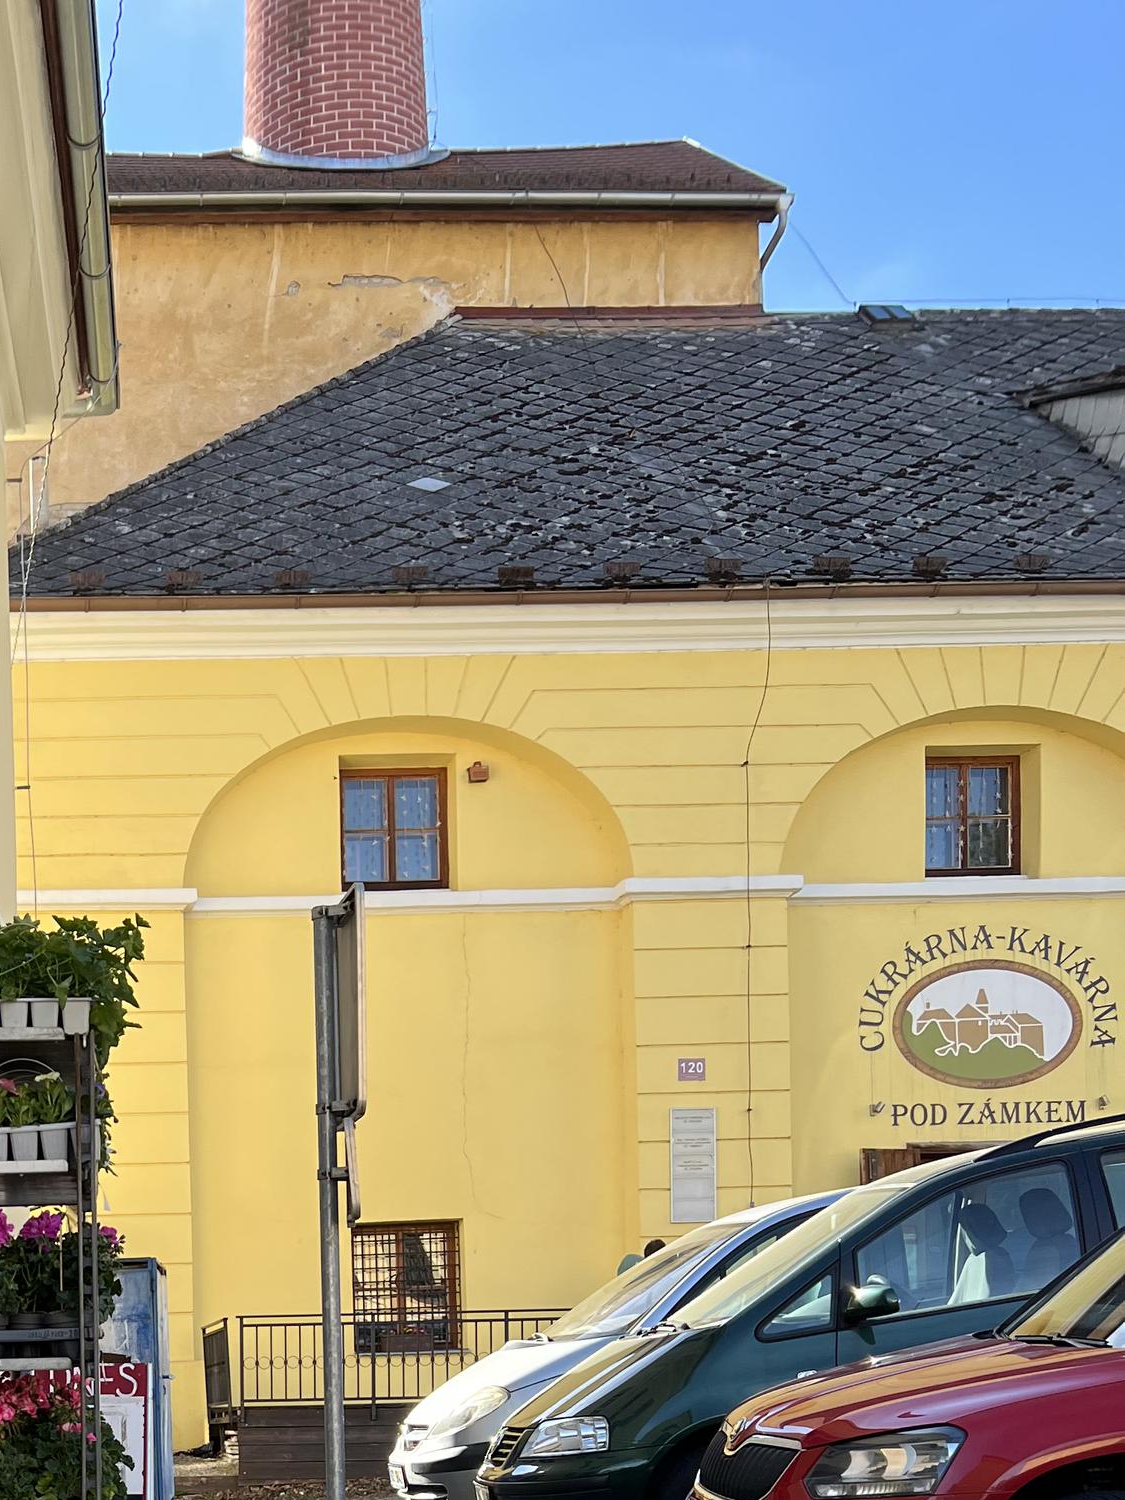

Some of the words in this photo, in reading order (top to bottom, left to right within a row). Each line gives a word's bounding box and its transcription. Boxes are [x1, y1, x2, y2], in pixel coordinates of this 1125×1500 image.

[858, 924, 1119, 1052] CUKRÁRNA-KAVÁRNA
[680, 1061, 704, 1074] 120
[891, 1102, 948, 1127] POD
[957, 1098, 1088, 1125] ZÁMKEM
